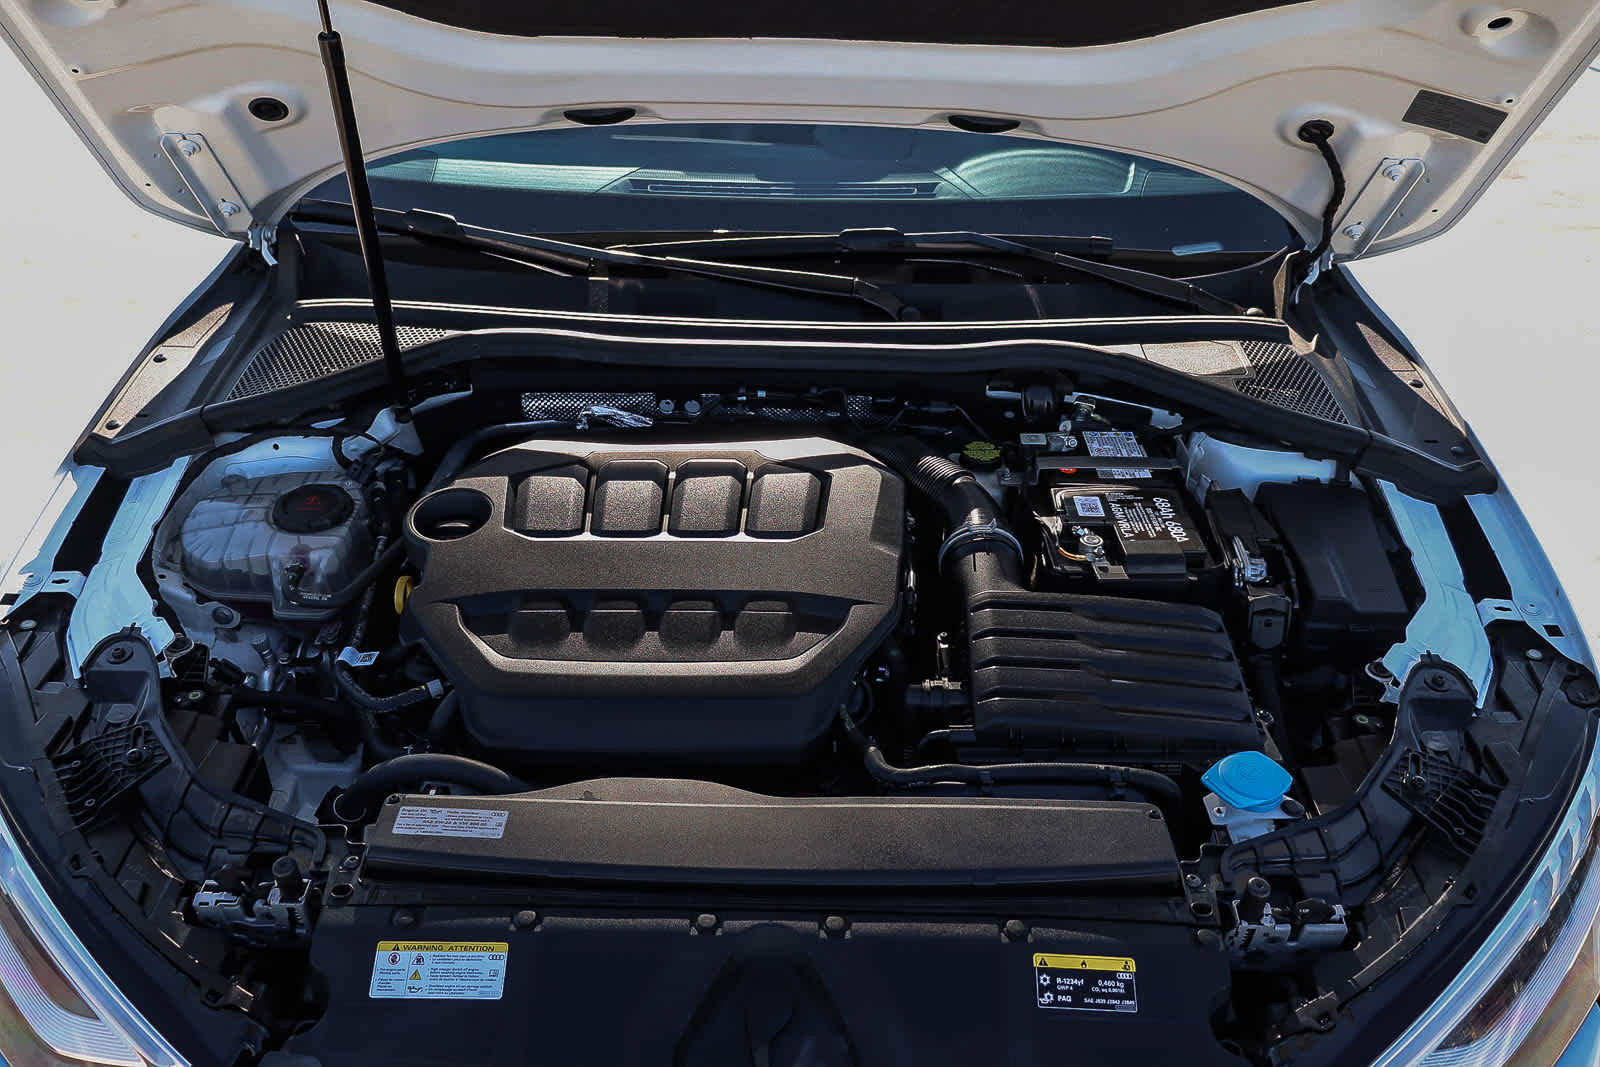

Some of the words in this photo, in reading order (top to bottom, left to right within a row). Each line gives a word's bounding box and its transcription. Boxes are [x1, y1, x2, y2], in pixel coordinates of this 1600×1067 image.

[1153, 497, 1176, 519] 68Ah
[1165, 521, 1189, 542] 680A
[401, 944, 444, 952] WARNING
[1056, 978, 1084, 986] R-1234yf
[1116, 980, 1125, 988] kg
[1057, 994, 1072, 1002] PAG
